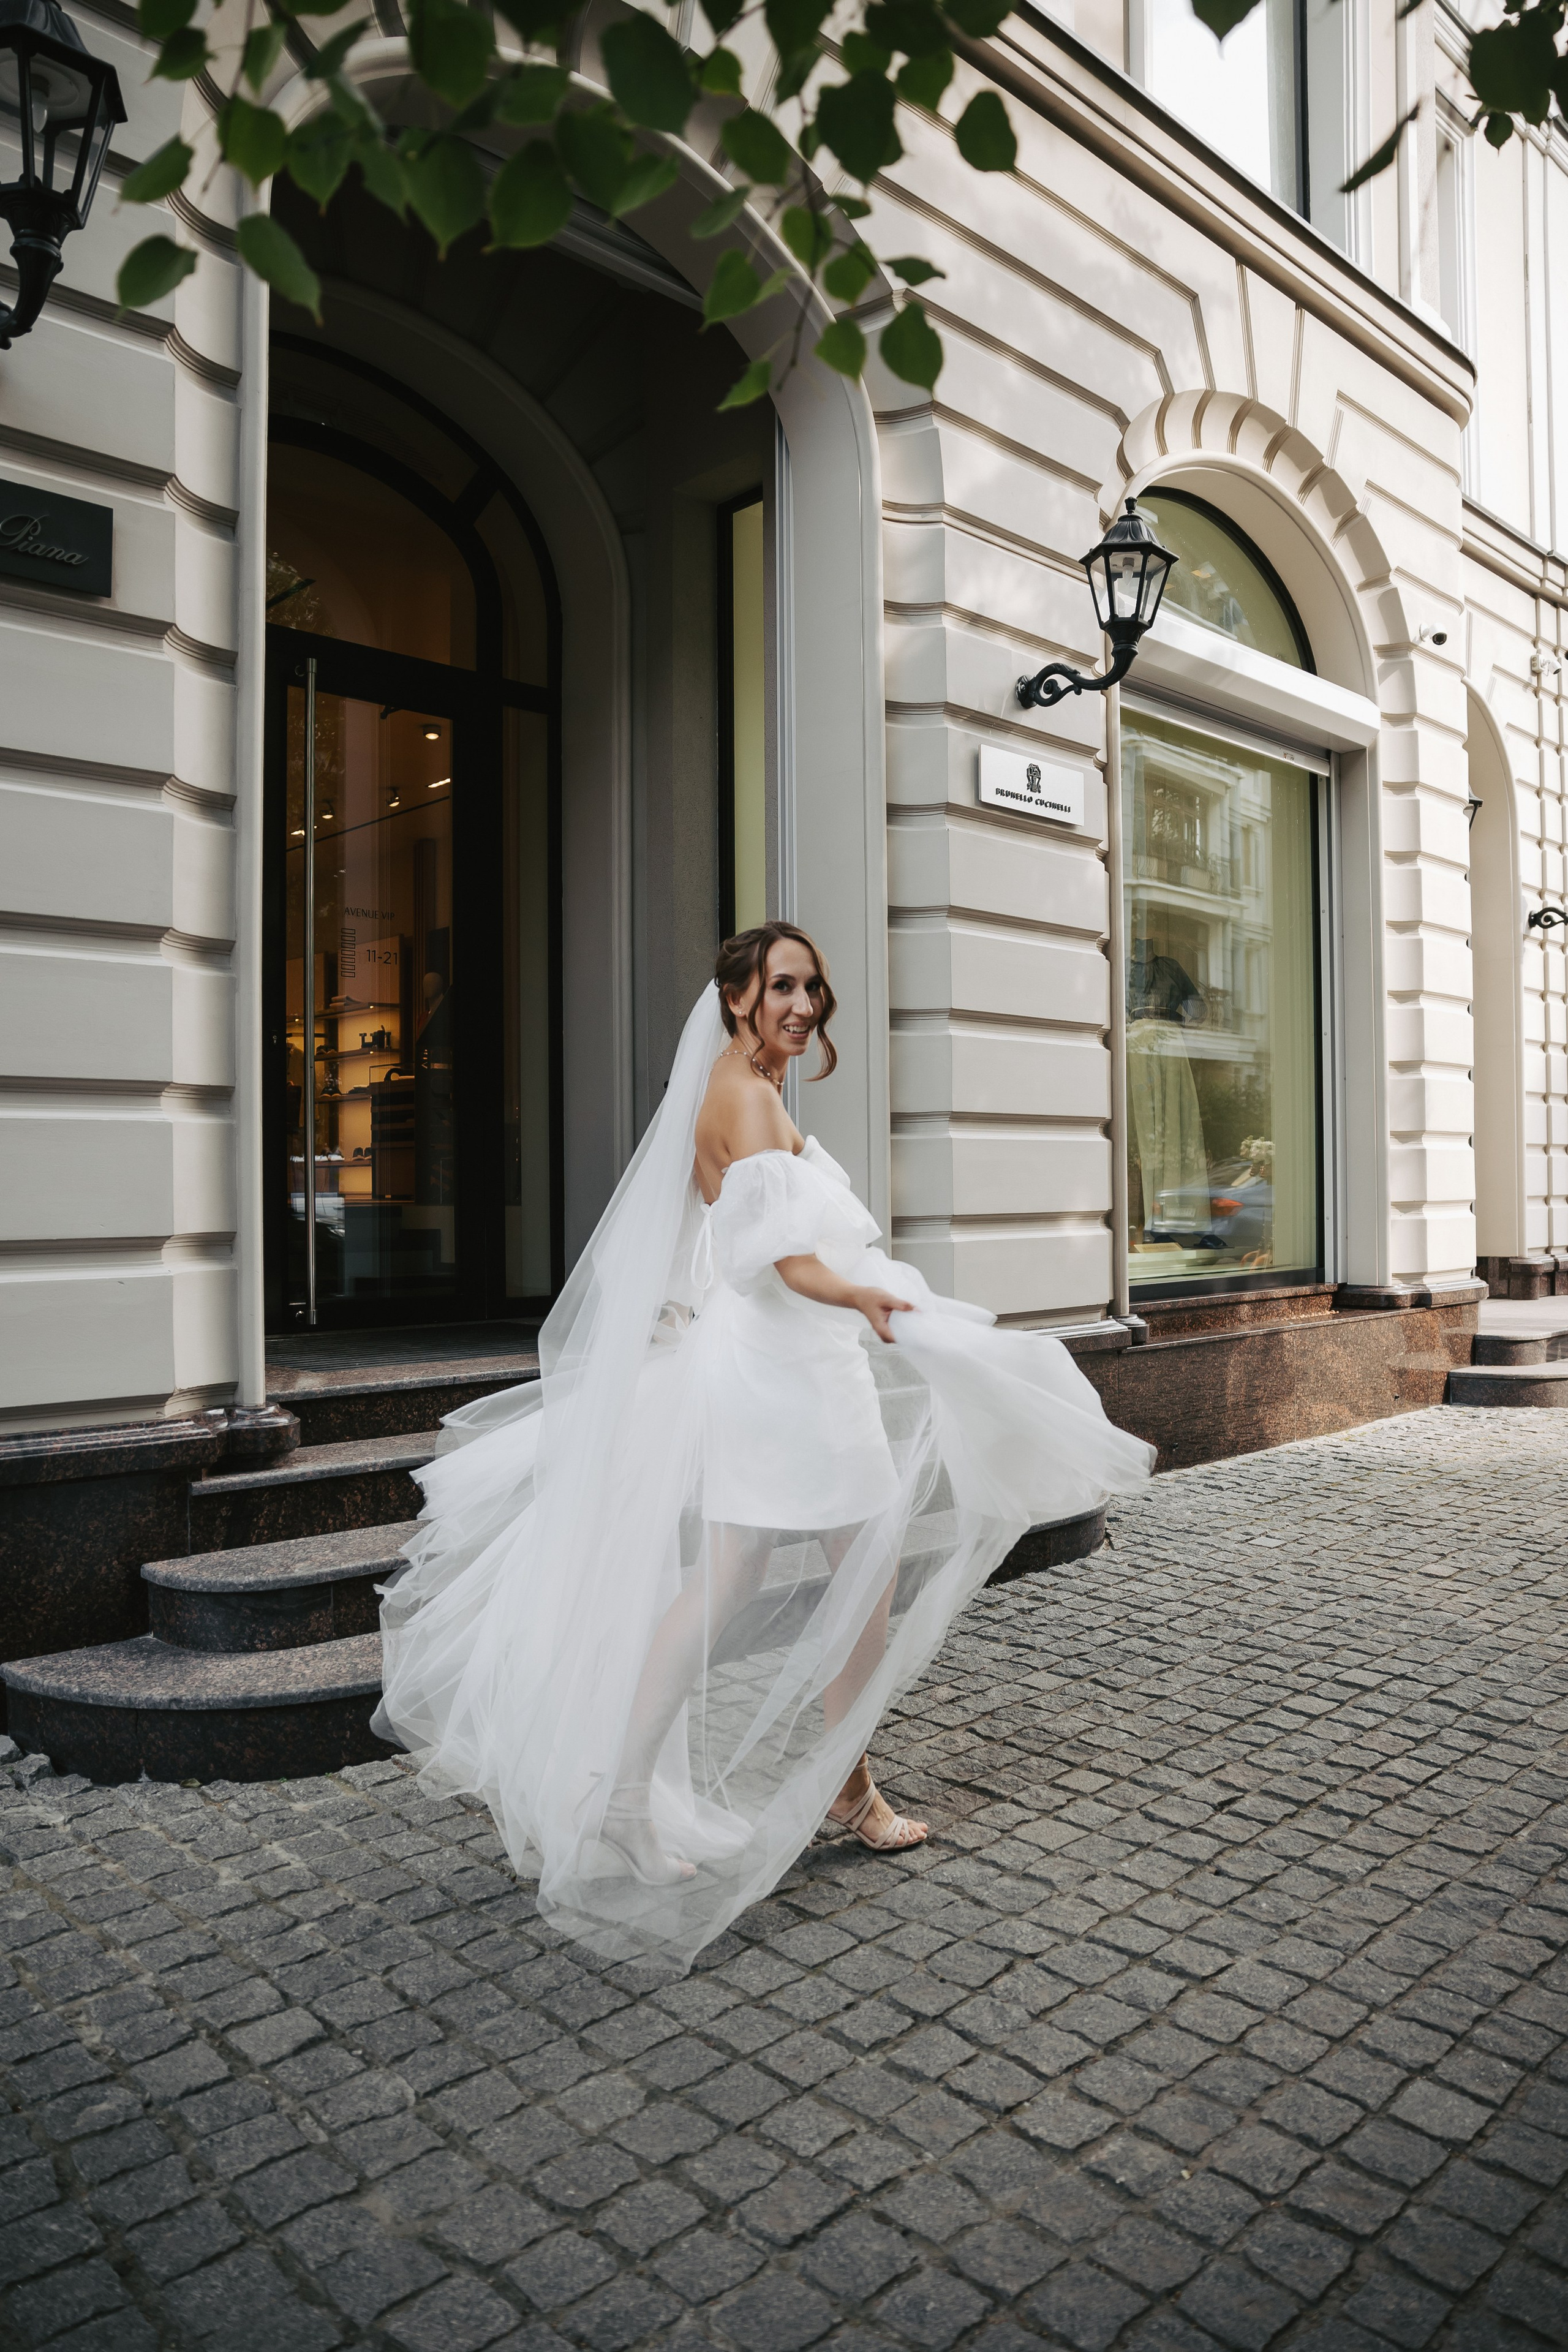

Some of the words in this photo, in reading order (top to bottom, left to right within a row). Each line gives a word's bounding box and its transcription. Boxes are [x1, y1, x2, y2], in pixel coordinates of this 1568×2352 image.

[0, 514, 89, 564] Piana
[995, 788, 1033, 804] BRUNELLO
[1035, 799, 1071, 813] CUCINELLI
[344, 907, 379, 919] AVENUE
[381, 911, 395, 921] VIP
[366, 949, 398, 965] 11-21
